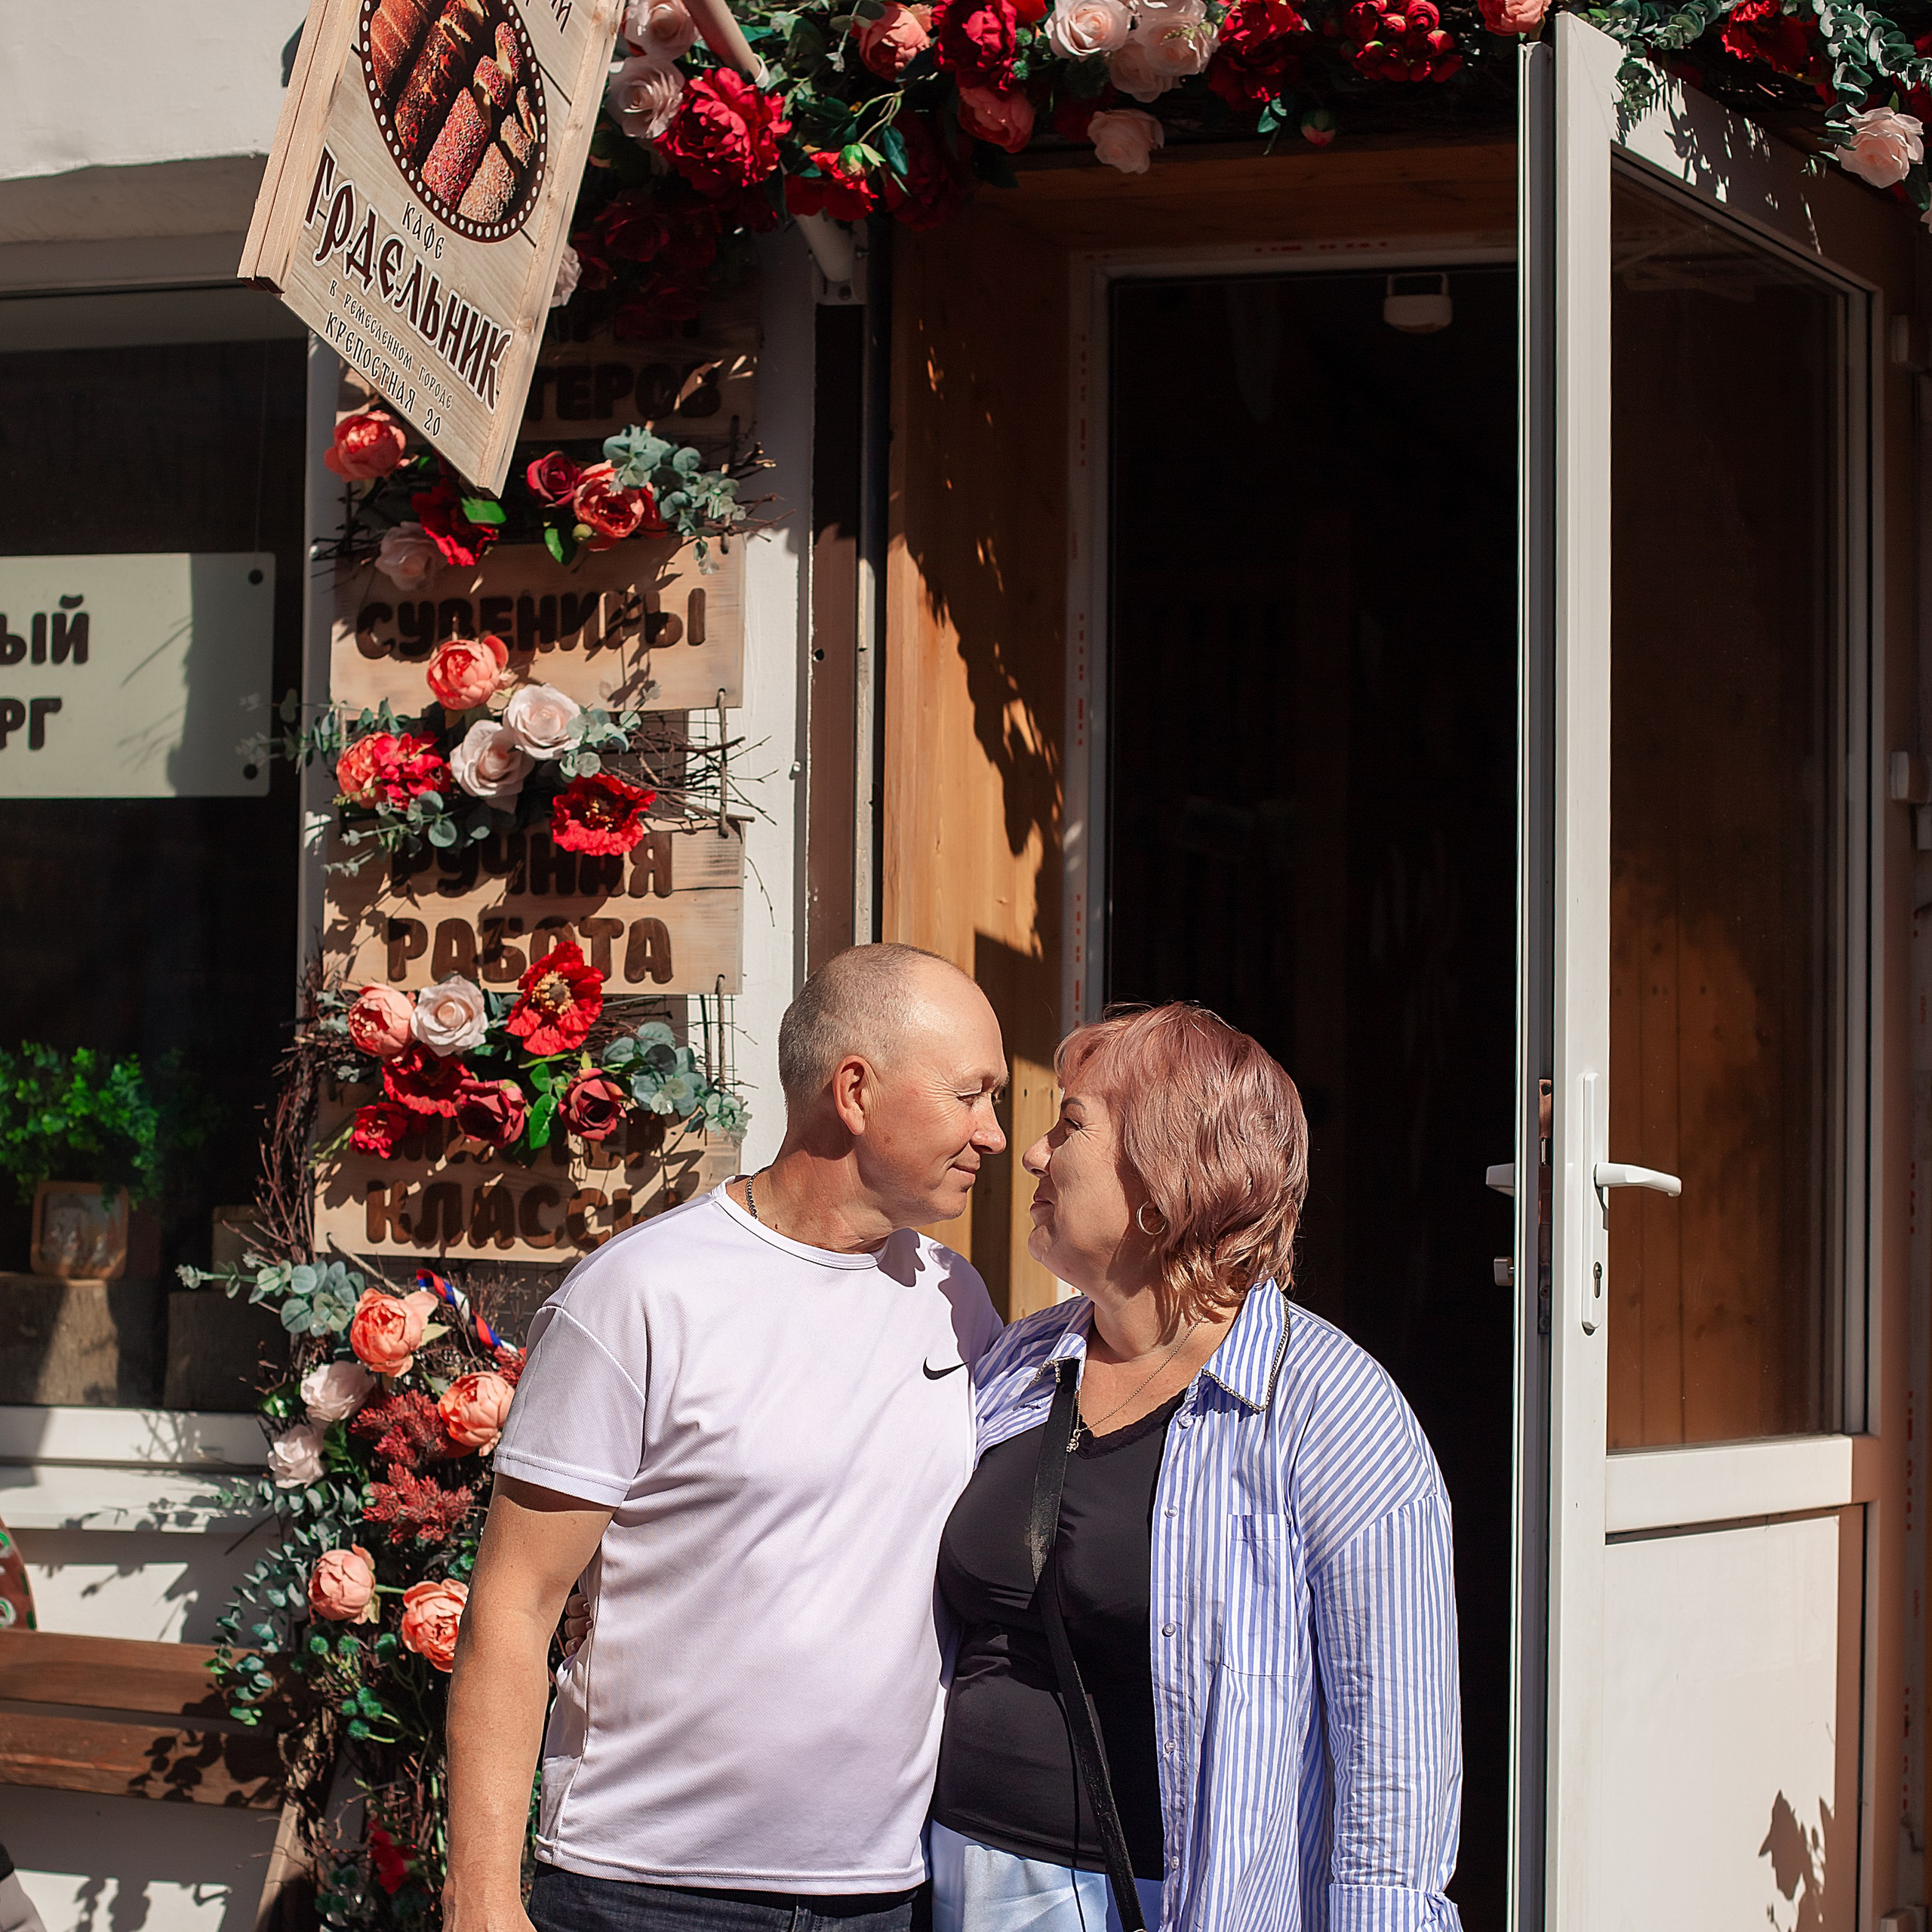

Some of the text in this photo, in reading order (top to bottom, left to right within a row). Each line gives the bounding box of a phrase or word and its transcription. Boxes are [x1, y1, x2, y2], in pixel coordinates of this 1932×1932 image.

[402, 202, 445, 259] КАФЕ
[325, 311, 441, 436] КРЕПОСТНАЯ 20
[343, 293, 414, 371] РЕМЕСЛЕННОМ
[418, 366, 453, 409] ГОРОДЕ
[527, 362, 722, 422] ТЕРОВ
[356, 588, 706, 661] СУВЕНИРЫ
[387, 916, 674, 983] РАБОТА
